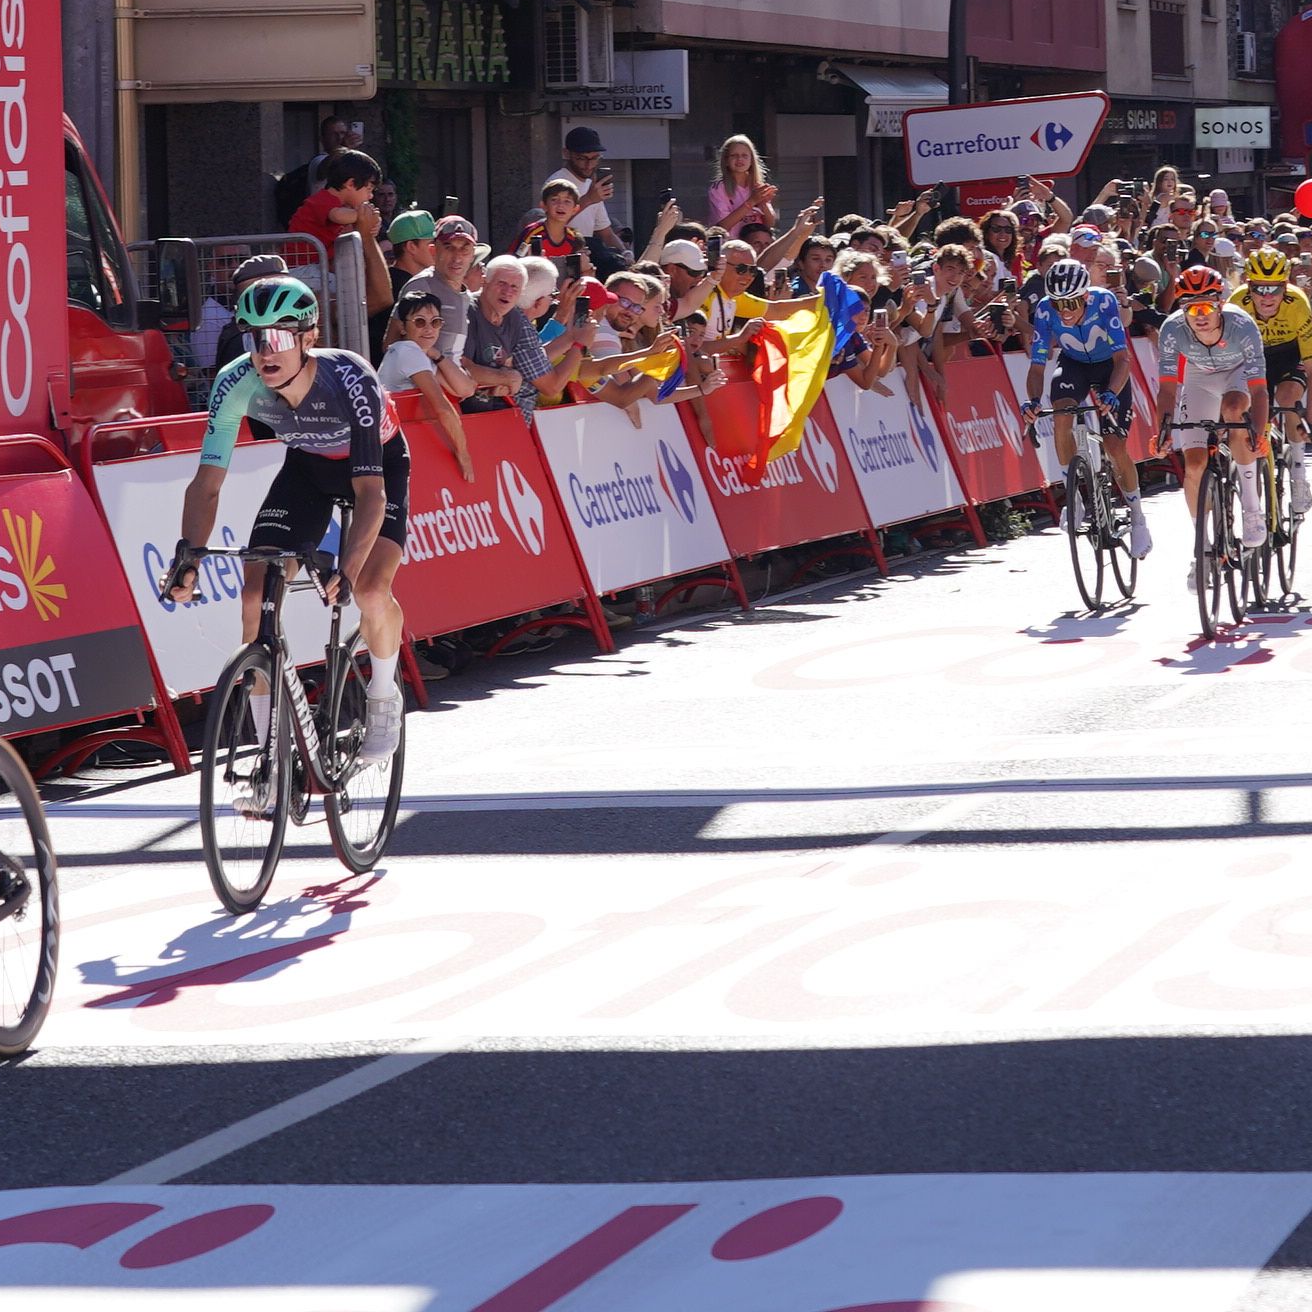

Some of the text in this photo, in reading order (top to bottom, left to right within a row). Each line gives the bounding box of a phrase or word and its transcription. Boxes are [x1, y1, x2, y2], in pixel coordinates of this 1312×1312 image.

[608, 84, 665, 96] estaurant
[613, 96, 673, 111] BAIXES
[917, 132, 1021, 158] Carrefour
[1201, 120, 1263, 135] SONOS
[209, 361, 255, 419] DECATHLON
[335, 363, 374, 428] Adecco
[849, 419, 915, 473] Carrefour
[946, 406, 1002, 455] Carrefour
[569, 462, 661, 528] Carrefour
